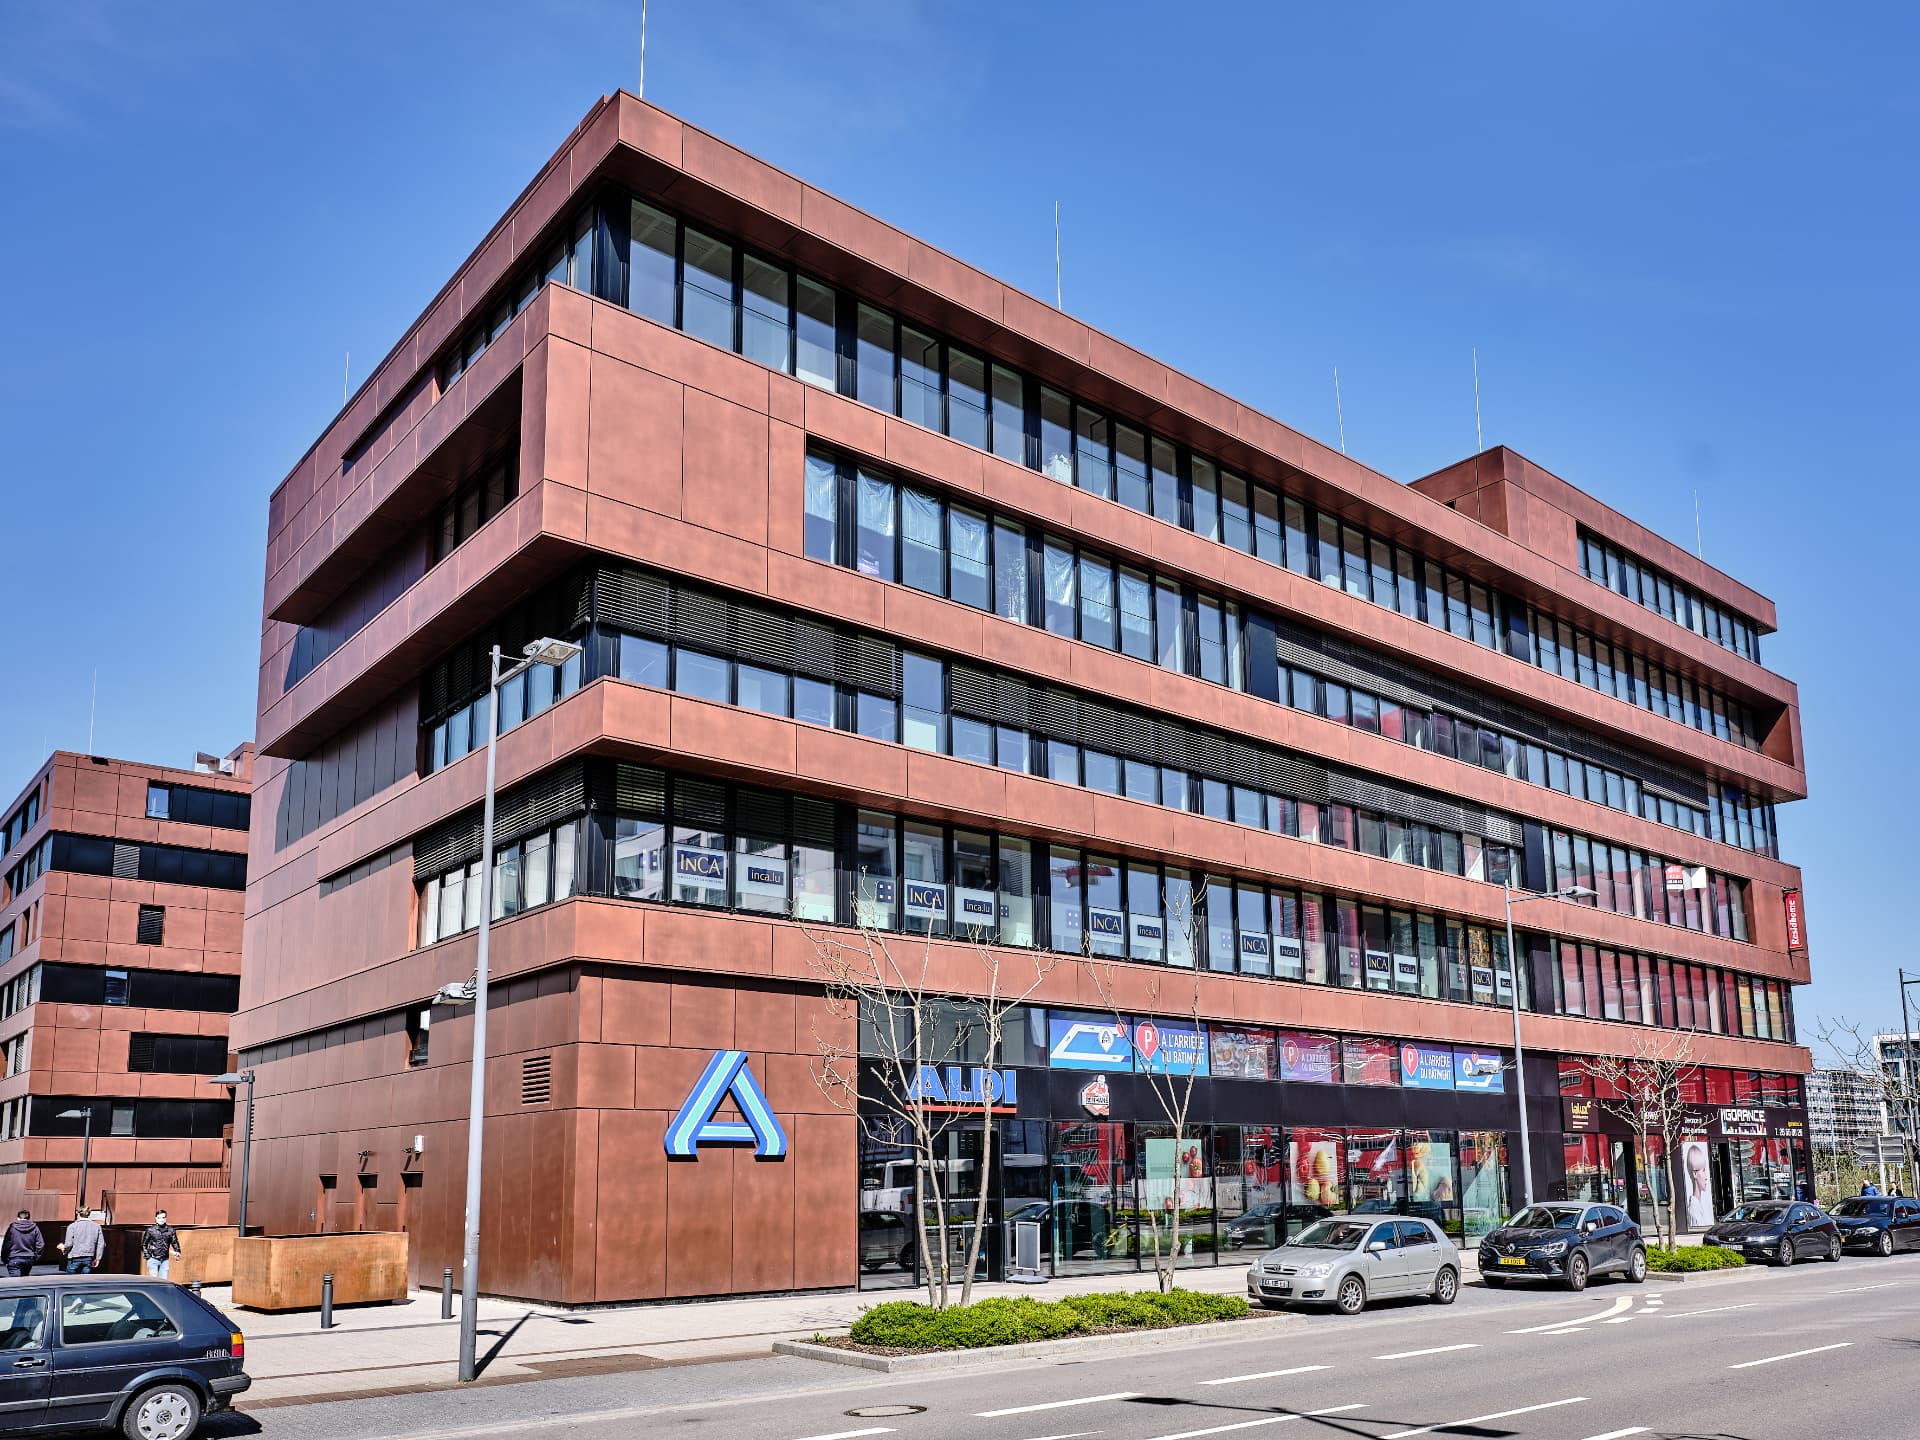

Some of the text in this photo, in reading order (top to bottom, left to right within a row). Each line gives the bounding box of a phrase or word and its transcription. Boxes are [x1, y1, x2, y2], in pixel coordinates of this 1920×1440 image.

[680, 853, 721, 876] INCA
[751, 869, 781, 883] inca.lu
[910, 887, 943, 907] INCA
[966, 901, 990, 913] inca.lu
[1093, 914, 1120, 933] INCA
[1789, 899, 1800, 945] Residhome
[1243, 937, 1266, 953] INCA
[1368, 956, 1388, 971] INCA
[1161, 1030, 1167, 1047] À
[905, 1065, 1017, 1104] ALDI
